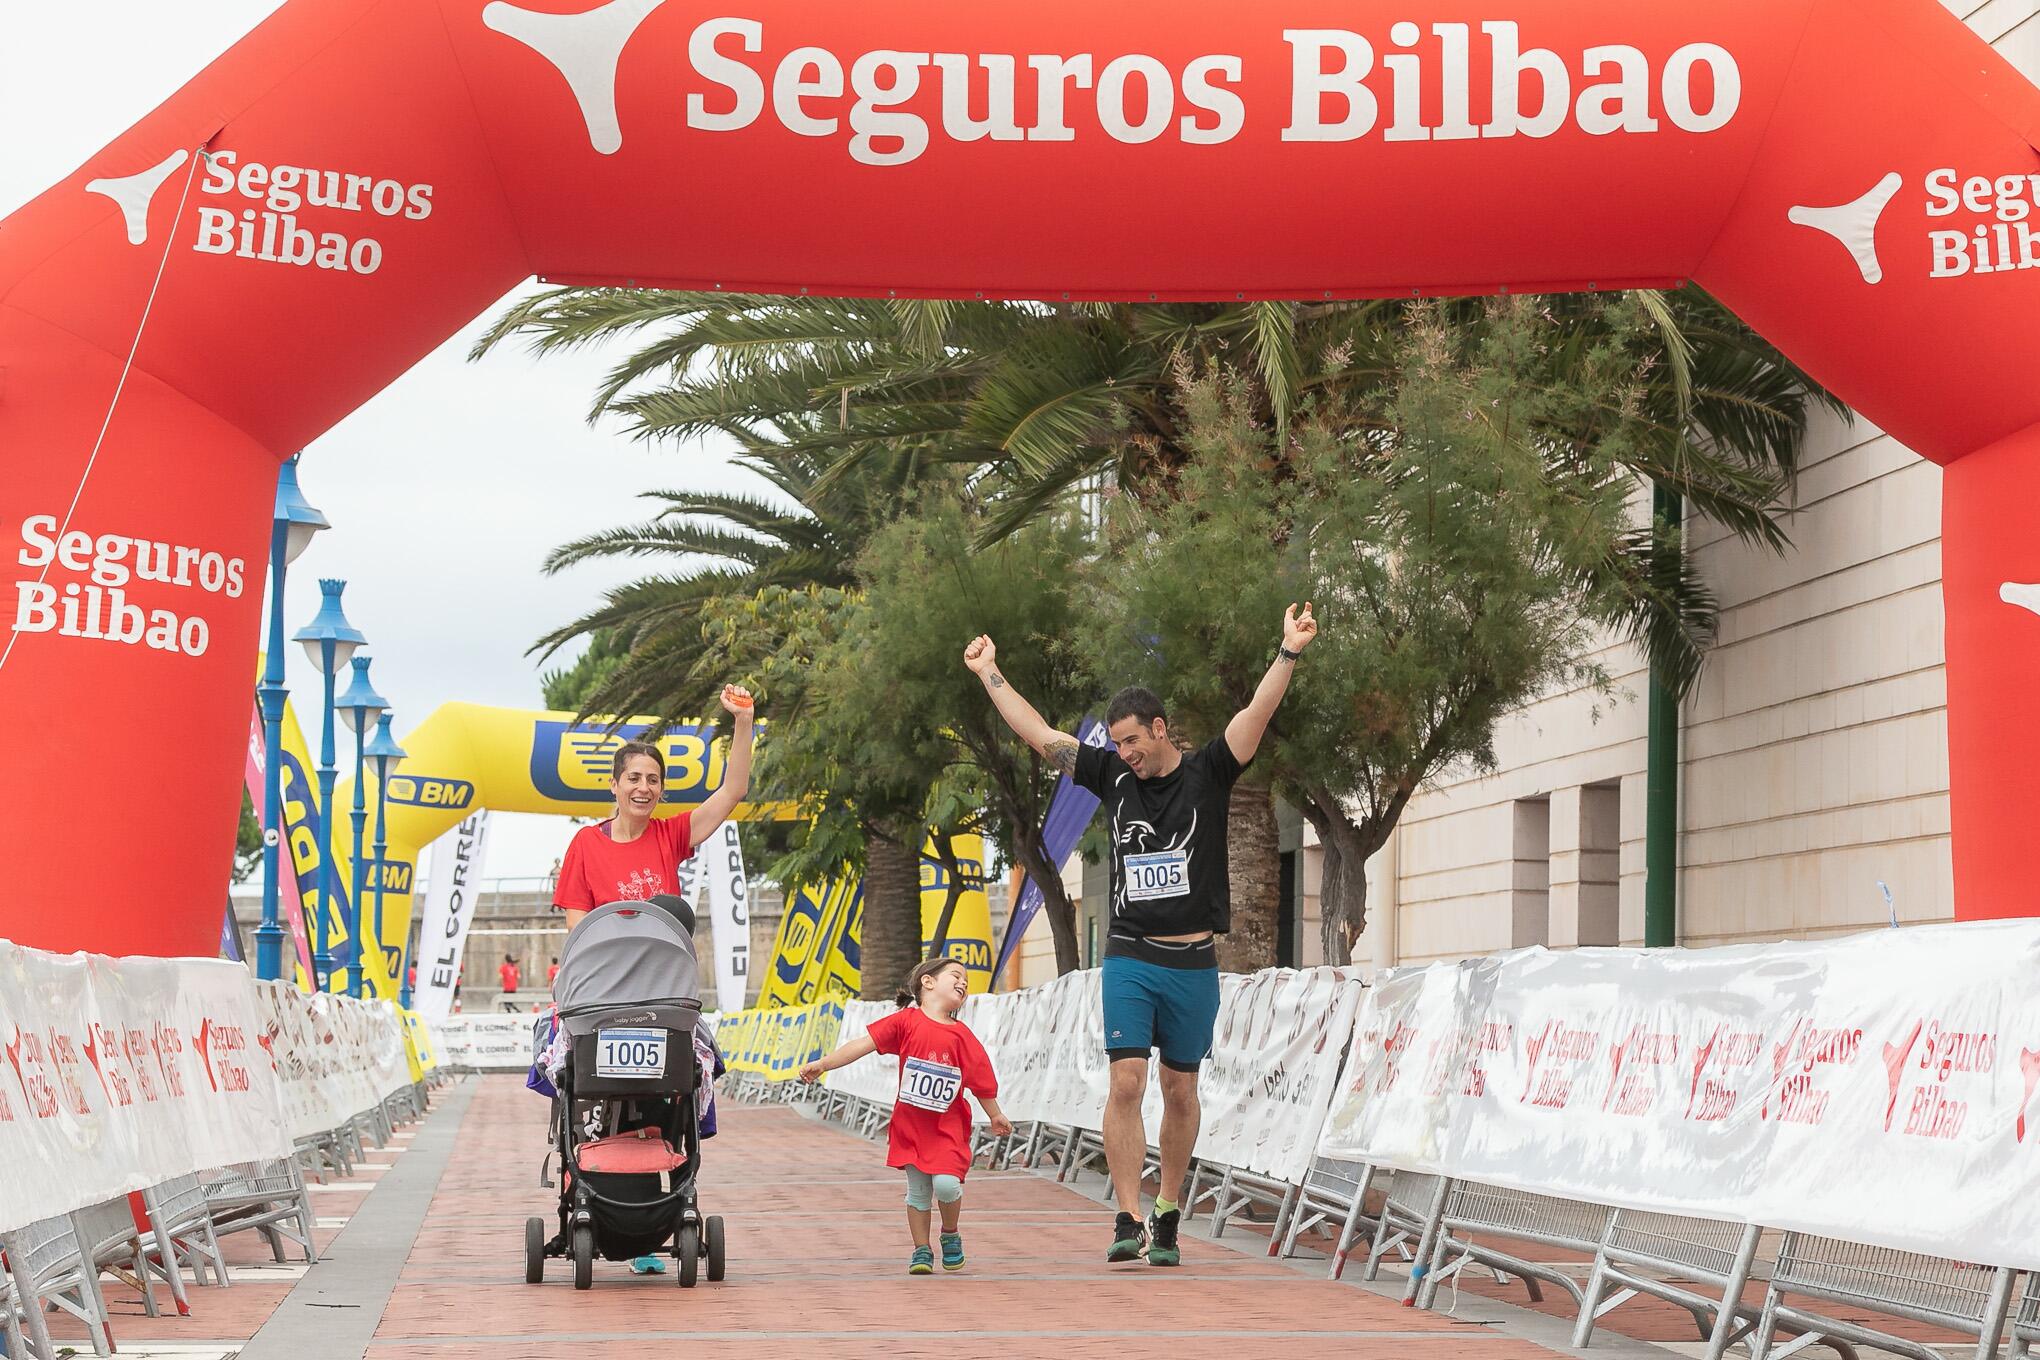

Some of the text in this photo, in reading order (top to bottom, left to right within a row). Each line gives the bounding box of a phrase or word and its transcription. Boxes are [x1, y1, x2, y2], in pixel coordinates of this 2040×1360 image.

[687, 16, 1741, 165] Seguros Bilbao
[201, 149, 433, 220] Seguros
[193, 207, 382, 274] Bilbao
[18, 514, 245, 598] Seguros
[11, 580, 209, 657] Bilbao
[420, 781, 469, 806] BM
[1133, 864, 1181, 889] 1005
[605, 1042, 659, 1066] 1005
[1919, 1019, 1997, 1083] Seguros
[911, 1071, 956, 1102] 1005
[1904, 1085, 1968, 1140] Bilbao
